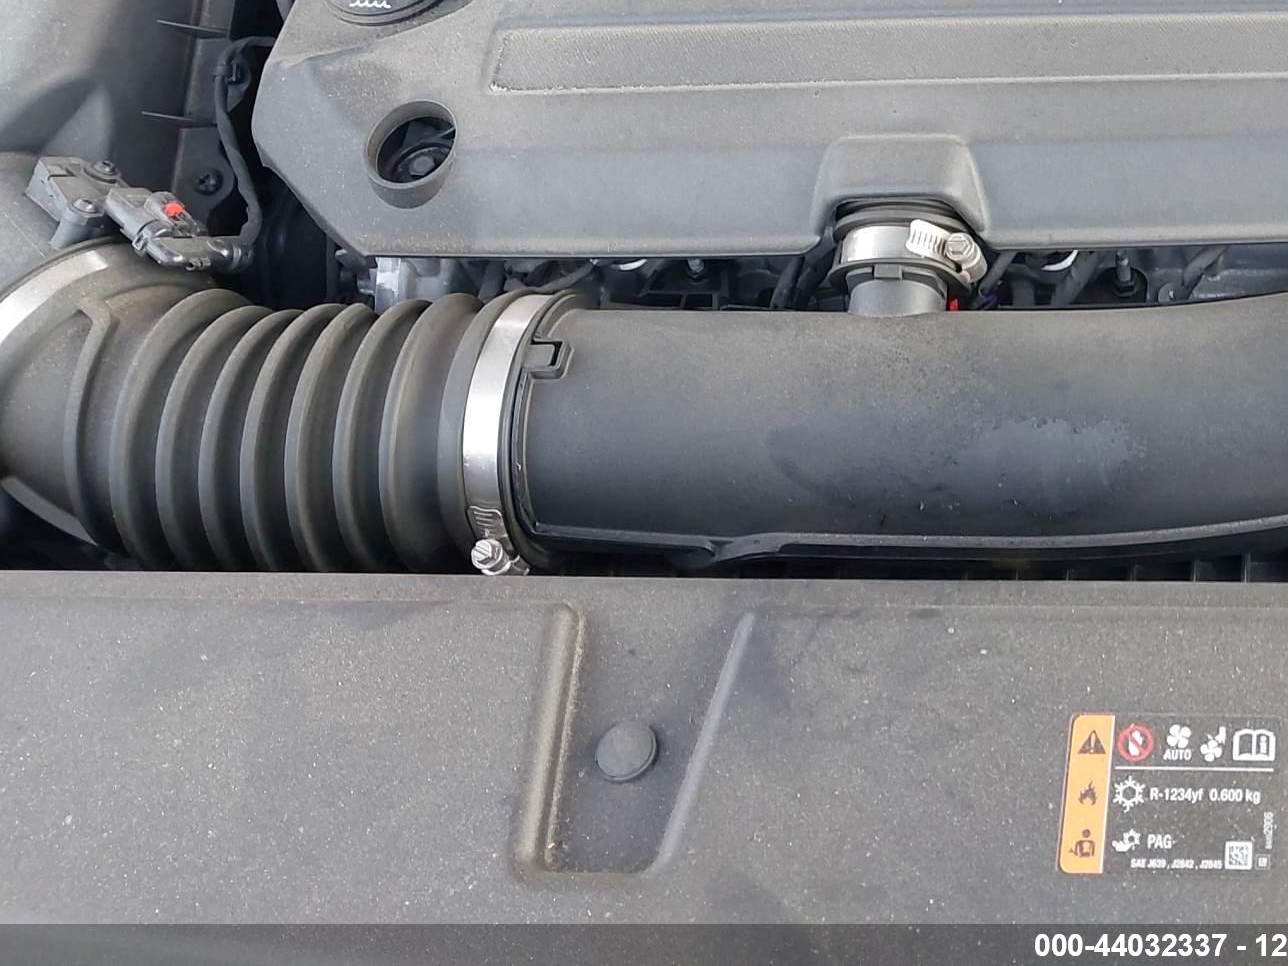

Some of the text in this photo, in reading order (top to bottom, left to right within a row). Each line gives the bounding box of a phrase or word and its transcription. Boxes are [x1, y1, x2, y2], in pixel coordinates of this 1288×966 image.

[1163, 749, 1192, 761] AUTO
[1149, 788, 1261, 805] R-1234yf 0.600 kg
[1147, 834, 1173, 849] PAG
